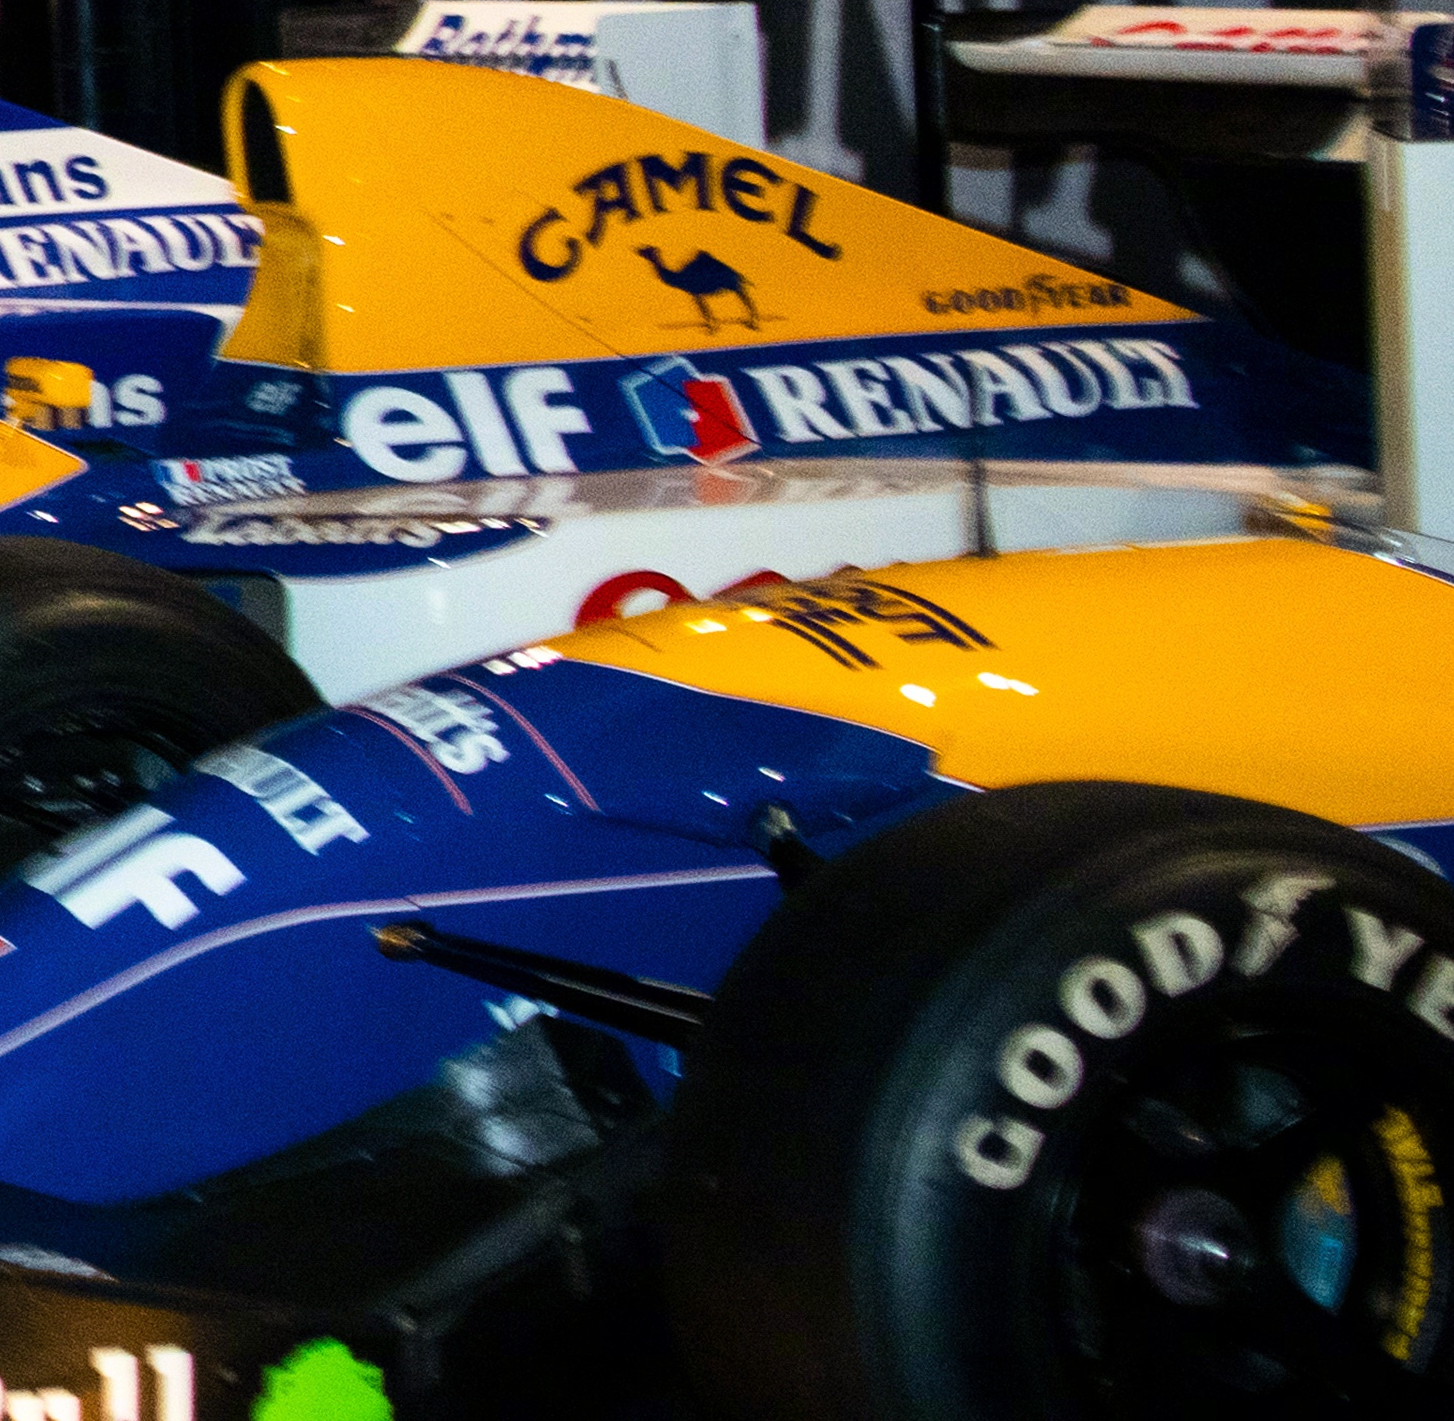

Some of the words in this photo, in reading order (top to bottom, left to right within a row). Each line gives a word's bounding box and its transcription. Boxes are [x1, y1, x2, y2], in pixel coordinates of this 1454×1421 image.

[517, 148, 844, 283] CAMEL
[342, 366, 593, 484] elf
[747, 337, 1201, 445] RENAULT
